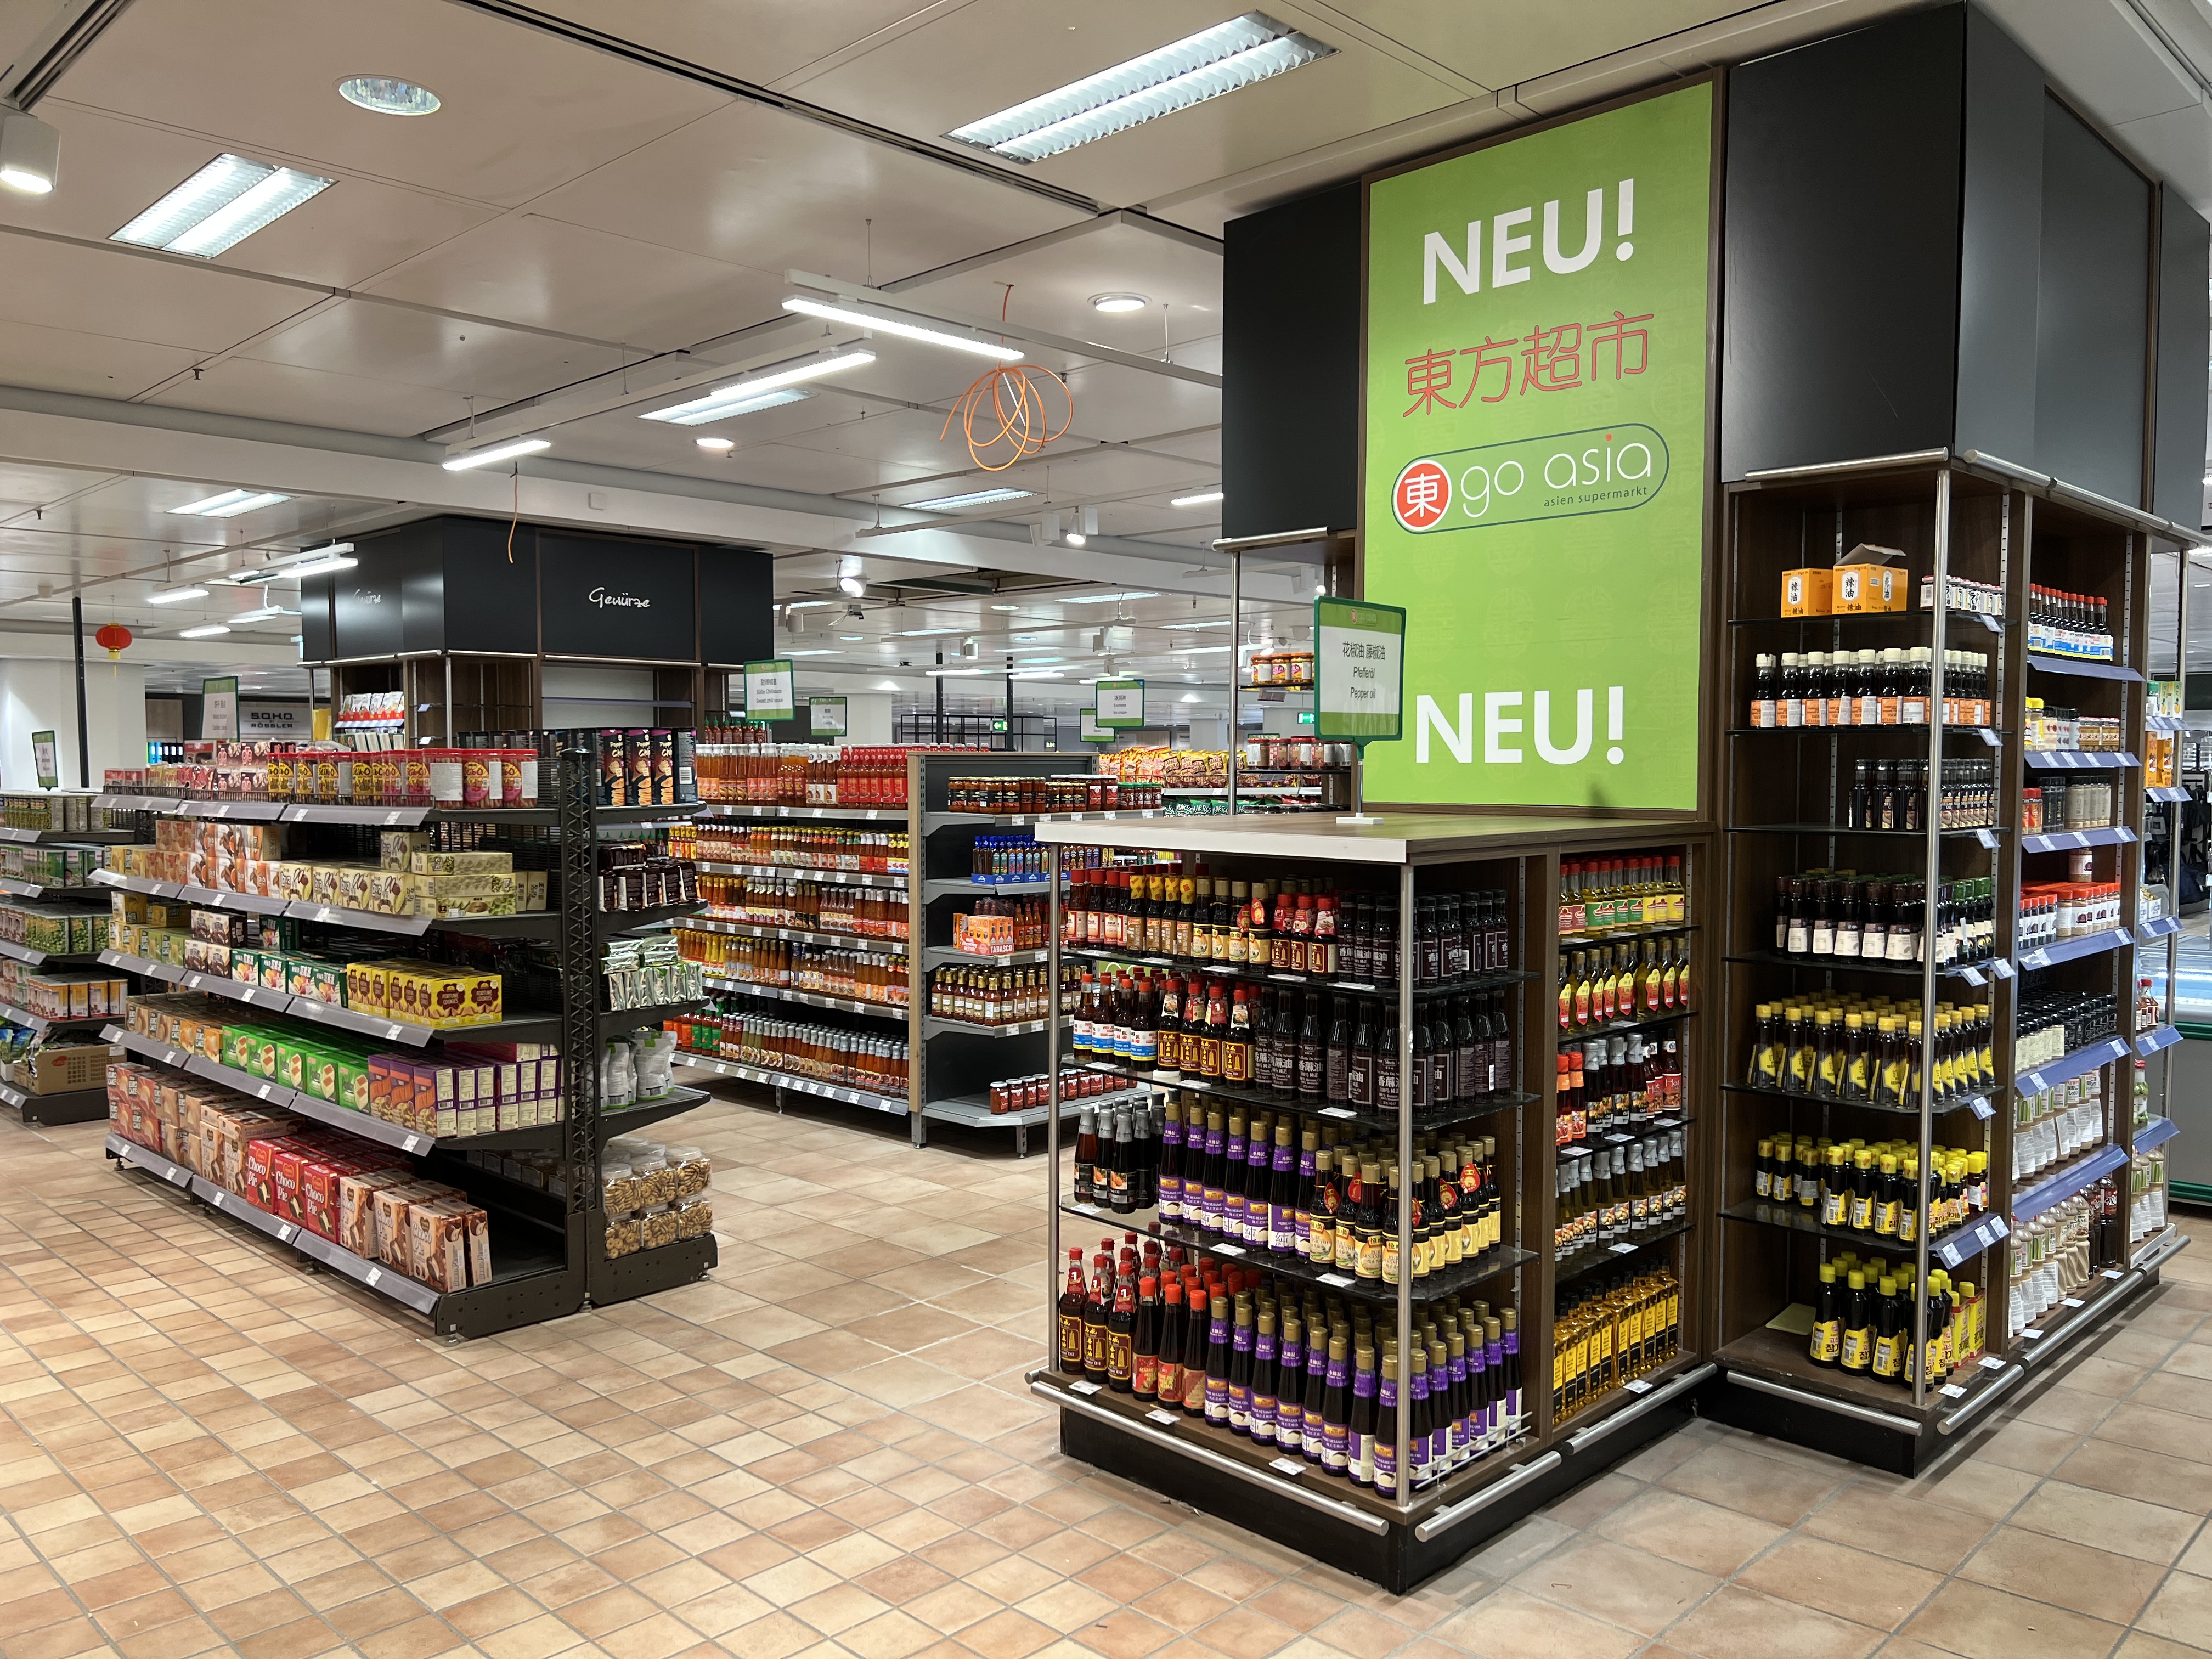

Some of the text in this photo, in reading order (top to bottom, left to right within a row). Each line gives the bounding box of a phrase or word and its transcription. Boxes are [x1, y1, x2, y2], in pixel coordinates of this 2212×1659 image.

[1423, 177, 1635, 305] NEU!
[1402, 310, 1655, 419] 東方超市
[1460, 433, 1652, 518] go asia
[1404, 473, 1441, 517] 東
[1544, 486, 1647, 507] asien supermarkt
[1791, 582, 1798, 602] 辣油
[1845, 577, 1855, 598] 辣油
[589, 586, 651, 610] Gewürze
[1353, 667, 1375, 679] Pfefferöl
[1350, 687, 1368, 701] Pepper
[1414, 684, 1624, 765] NEU!
[990, 945, 1012, 953] TABASCO
[1666, 1078, 1679, 1087] Hot
[249, 1156, 266, 1175] Choco
[248, 1171, 258, 1187] Pie
[276, 1171, 295, 1189] Choco
[278, 1186, 288, 1202] Pie
[306, 1183, 324, 1203] Choco
[308, 1200, 318, 1216] Pie
[413, 1223, 431, 1243] Choco
[414, 1239, 424, 1255] Pie
